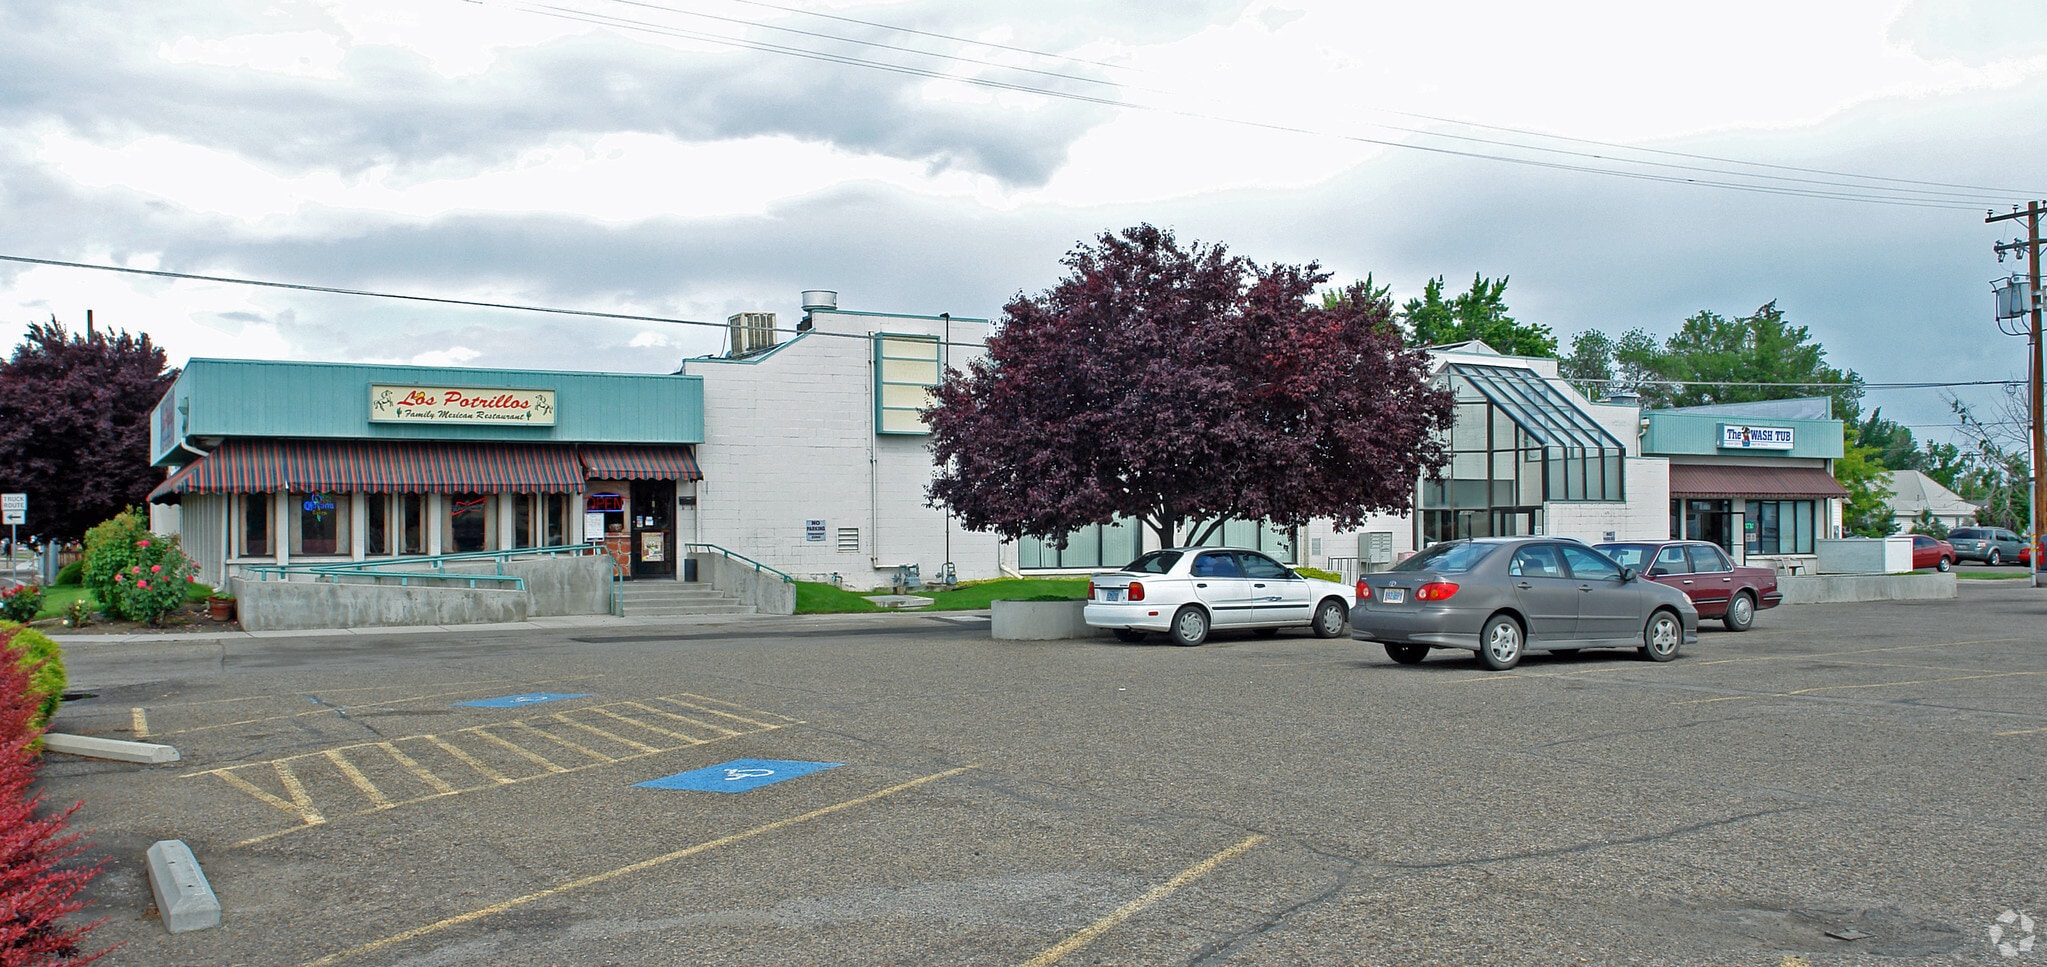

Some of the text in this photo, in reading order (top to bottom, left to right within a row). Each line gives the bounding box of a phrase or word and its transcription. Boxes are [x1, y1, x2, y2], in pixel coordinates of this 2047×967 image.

[397, 390, 532, 409] Los Potrillos
[404, 409, 526, 420] Family Mexican Restaurant
[1727, 428, 1791, 442] The WASH TUB
[587, 497, 623, 510] OPEN
